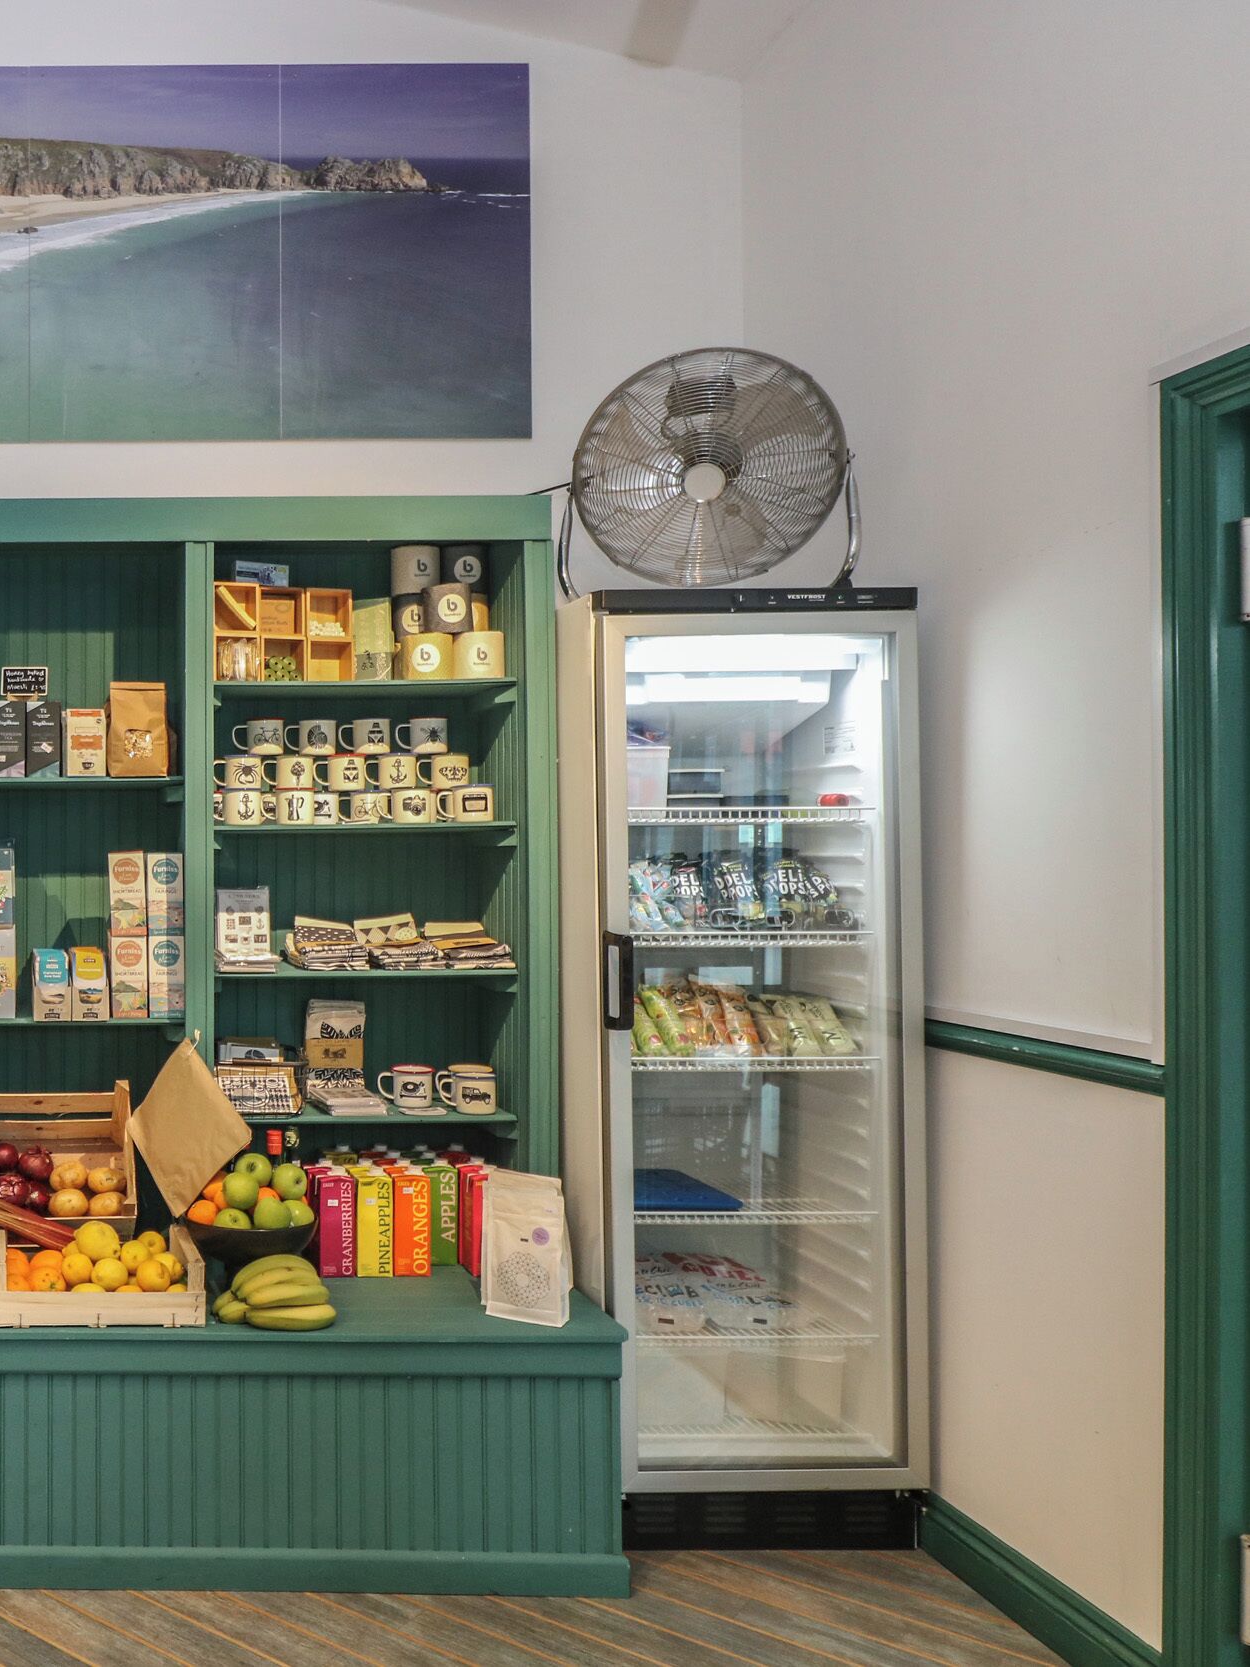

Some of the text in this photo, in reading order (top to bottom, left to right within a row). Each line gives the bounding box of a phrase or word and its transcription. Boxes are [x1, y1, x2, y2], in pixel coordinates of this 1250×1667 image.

[341, 1181, 353, 1276] CRANBERRIES
[377, 1181, 391, 1275] PINEAPPLES
[412, 1180, 428, 1274] ORANGES
[440, 1172, 456, 1243] APPLES
